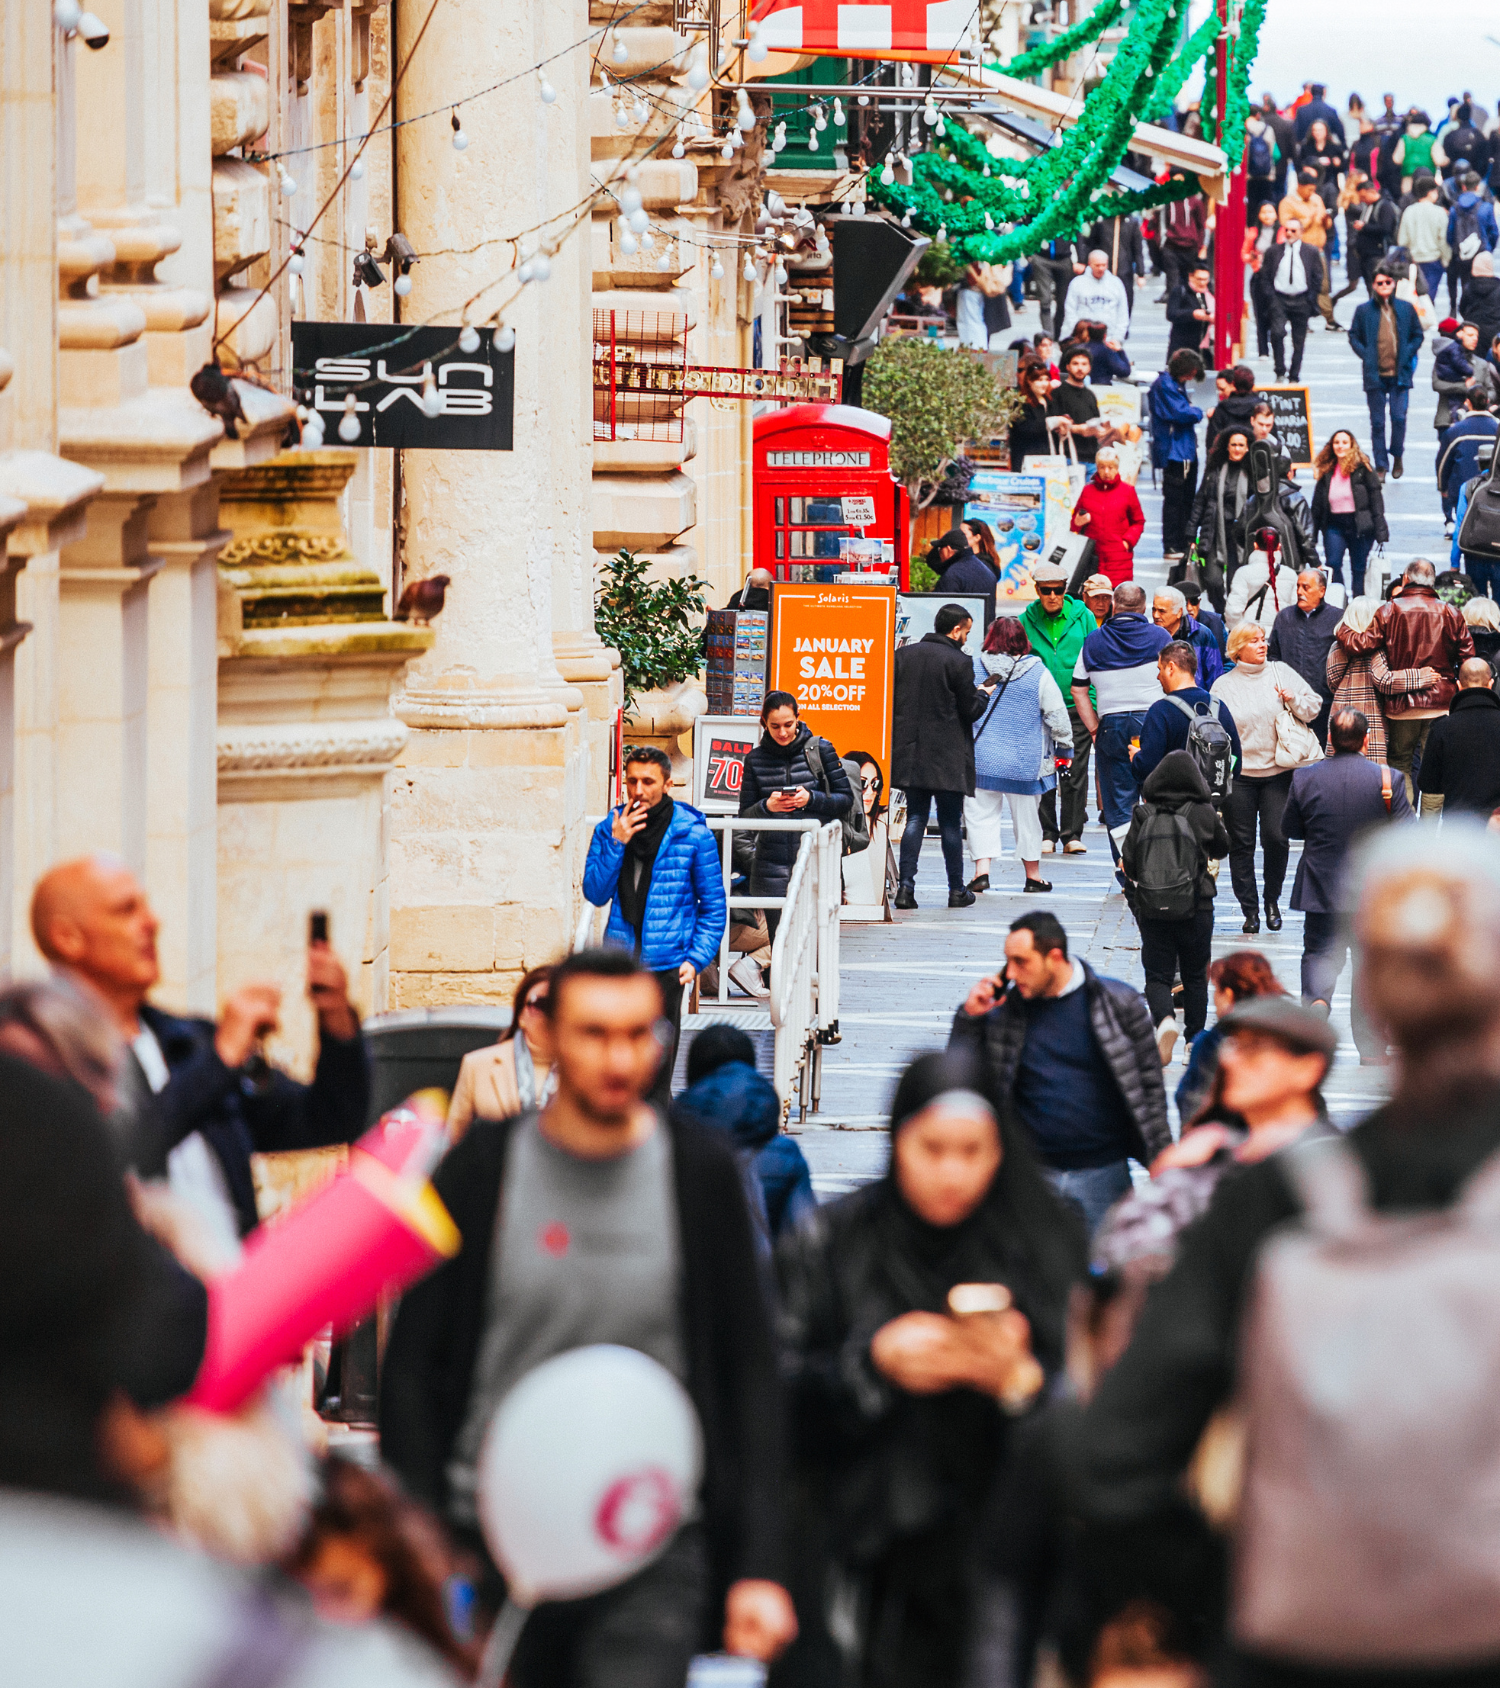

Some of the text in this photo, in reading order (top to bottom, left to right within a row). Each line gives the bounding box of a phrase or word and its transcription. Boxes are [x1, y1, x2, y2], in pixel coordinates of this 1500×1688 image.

[315, 357, 494, 387] SUN
[314, 384, 493, 416] LAB
[772, 452, 867, 465] TELEPHONE
[817, 593, 849, 604] Solaris
[793, 637, 874, 654] JANUARY
[799, 656, 866, 679] SALE
